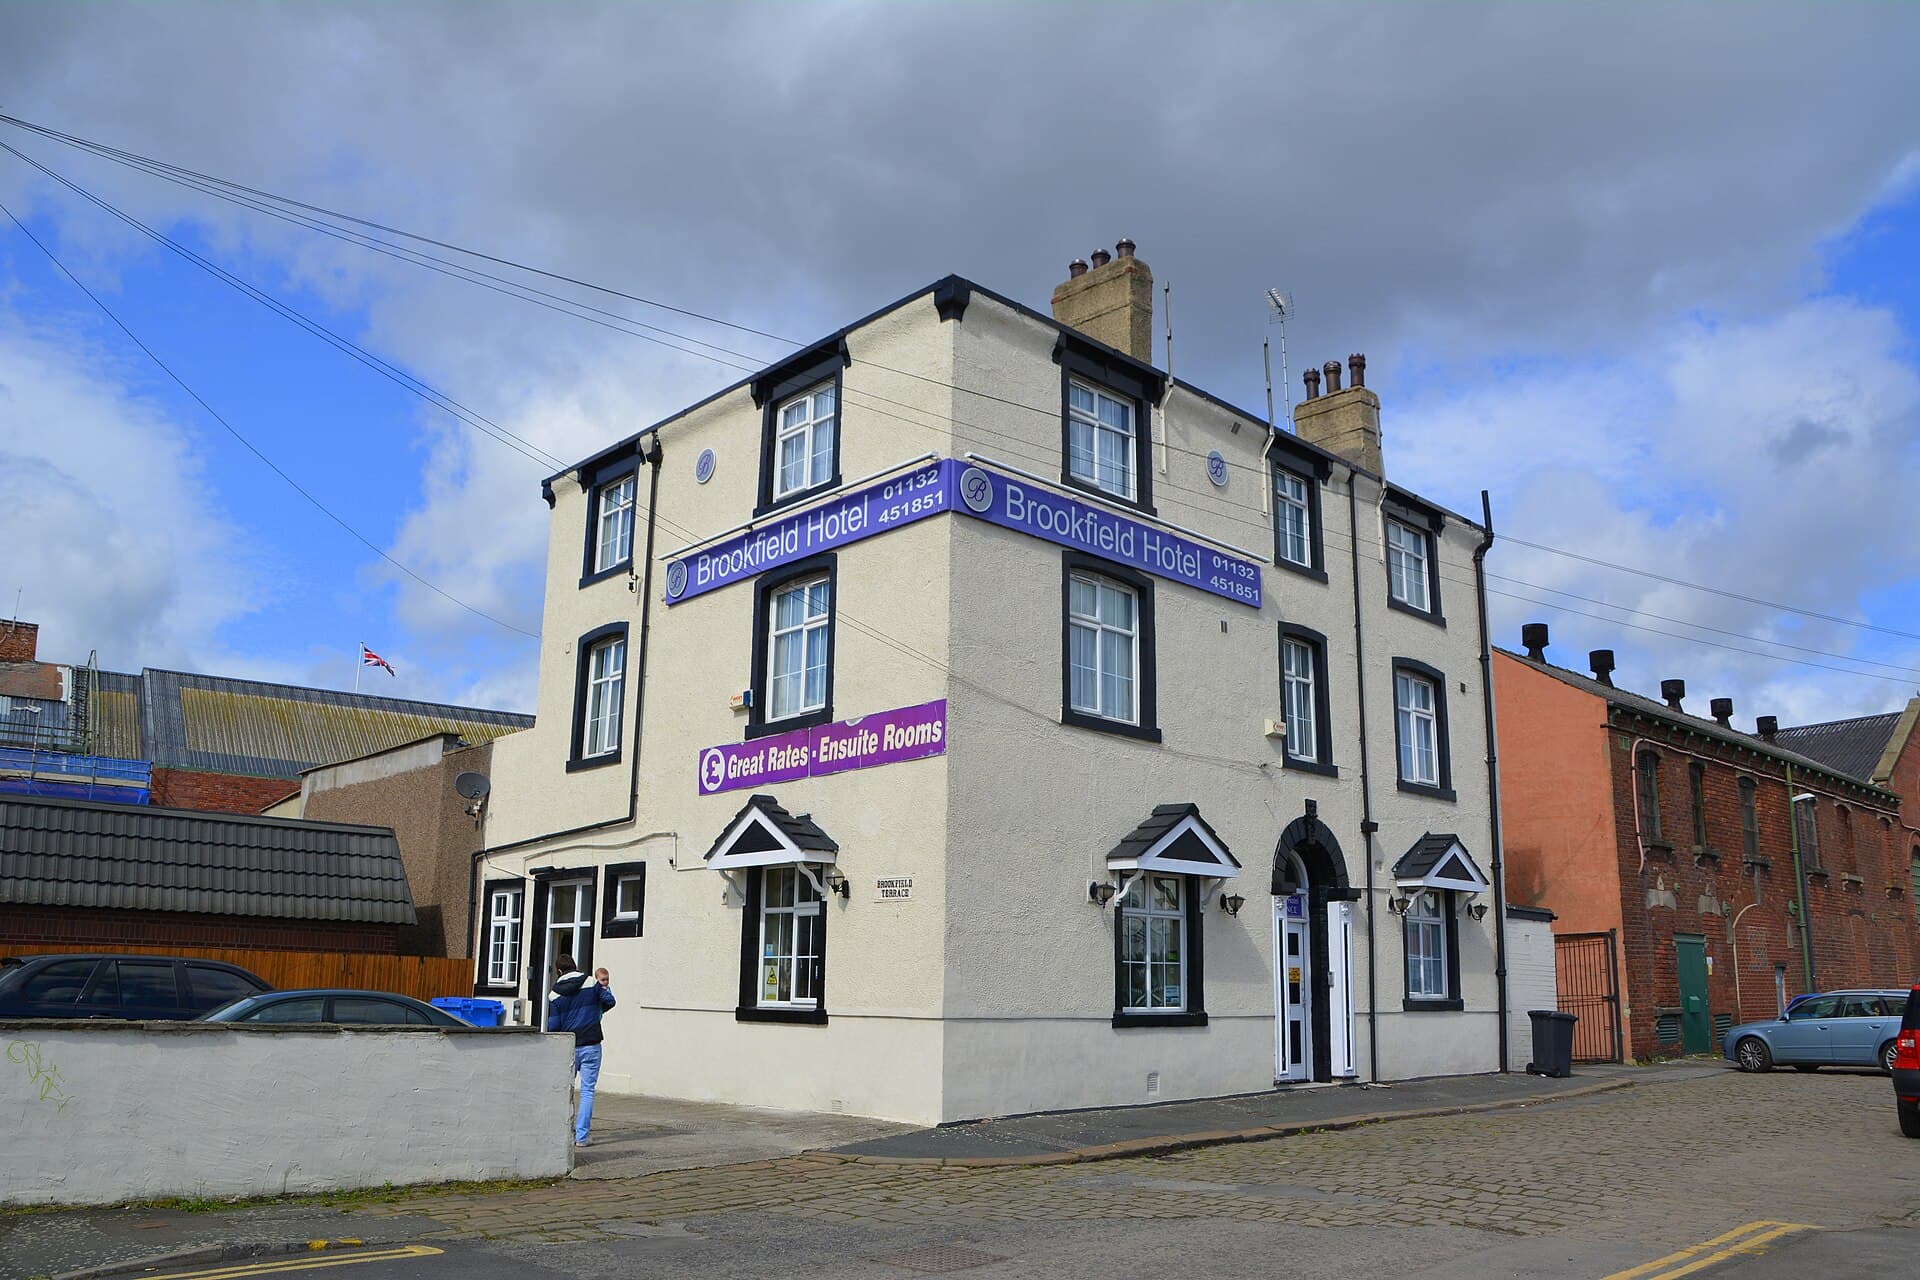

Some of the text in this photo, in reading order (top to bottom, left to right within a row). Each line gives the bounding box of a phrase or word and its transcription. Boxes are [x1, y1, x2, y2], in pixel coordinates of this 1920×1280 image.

[883, 469, 939, 500] 01132
[878, 490, 944, 524] 451851
[697, 494, 869, 586] Brookfield Hotel
[1005, 485, 1201, 580] Brookfield Hotel
[1212, 555, 1255, 581] 01132
[1209, 575, 1260, 602] 451851
[727, 749, 765, 779] Great
[767, 744, 809, 772] Rates
[819, 729, 879, 763] Ensuite
[883, 720, 943, 752] Rooms
[877, 879, 913, 889] BROOKFIELD
[881, 888, 910, 898] TERRACE
